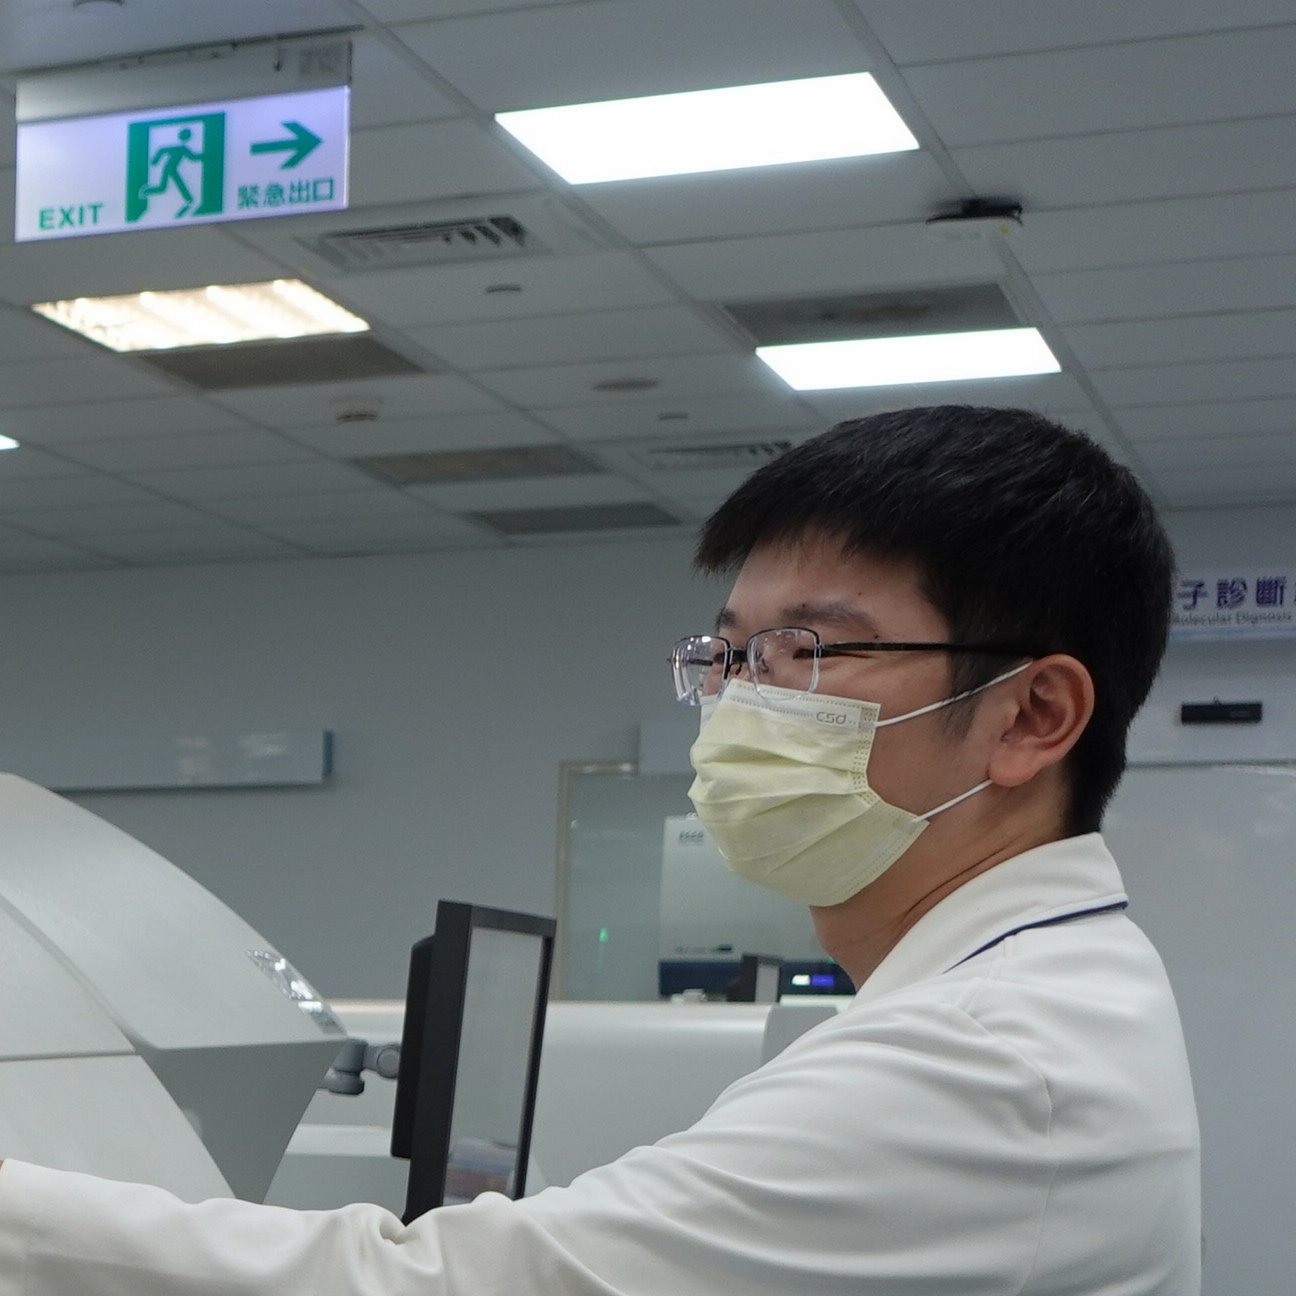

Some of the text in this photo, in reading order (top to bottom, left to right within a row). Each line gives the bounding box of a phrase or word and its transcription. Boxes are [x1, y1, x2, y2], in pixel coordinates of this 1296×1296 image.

[236, 177, 335, 209] 緊急出口
[38, 203, 105, 231] EXIT
[1176, 576, 1296, 609] 子診斷
